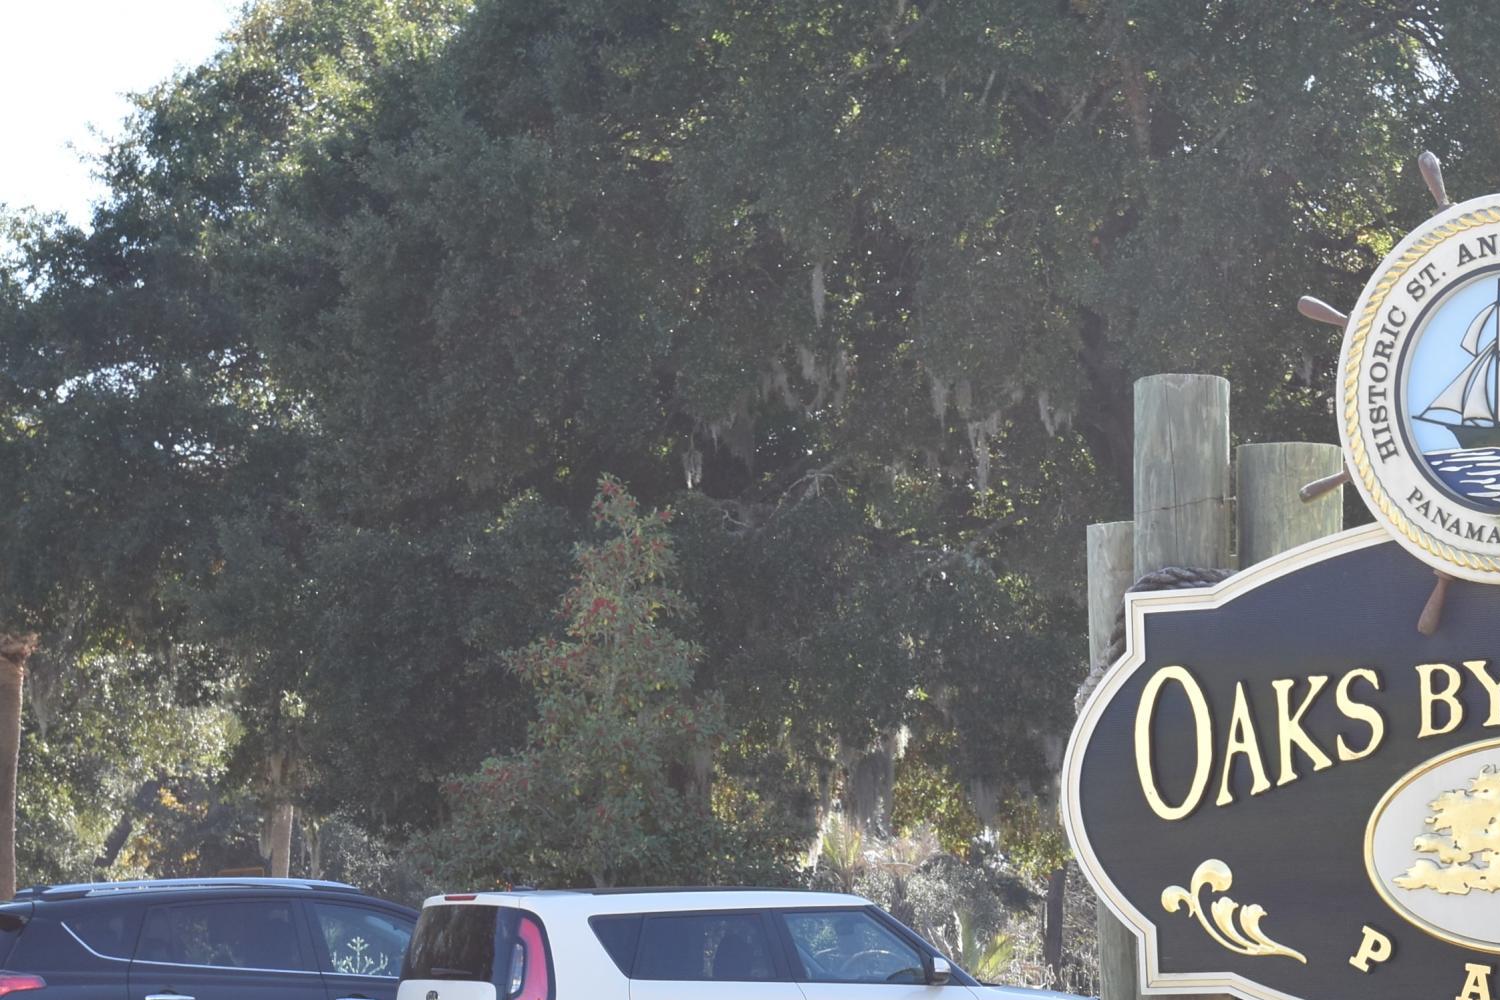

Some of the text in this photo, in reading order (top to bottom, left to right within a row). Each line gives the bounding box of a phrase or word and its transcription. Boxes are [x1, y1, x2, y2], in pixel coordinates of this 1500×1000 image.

[1369, 306, 1408, 463] HISTORIC
[1406, 263, 1446, 302] ST.
[1134, 665, 1385, 821] OAKS
